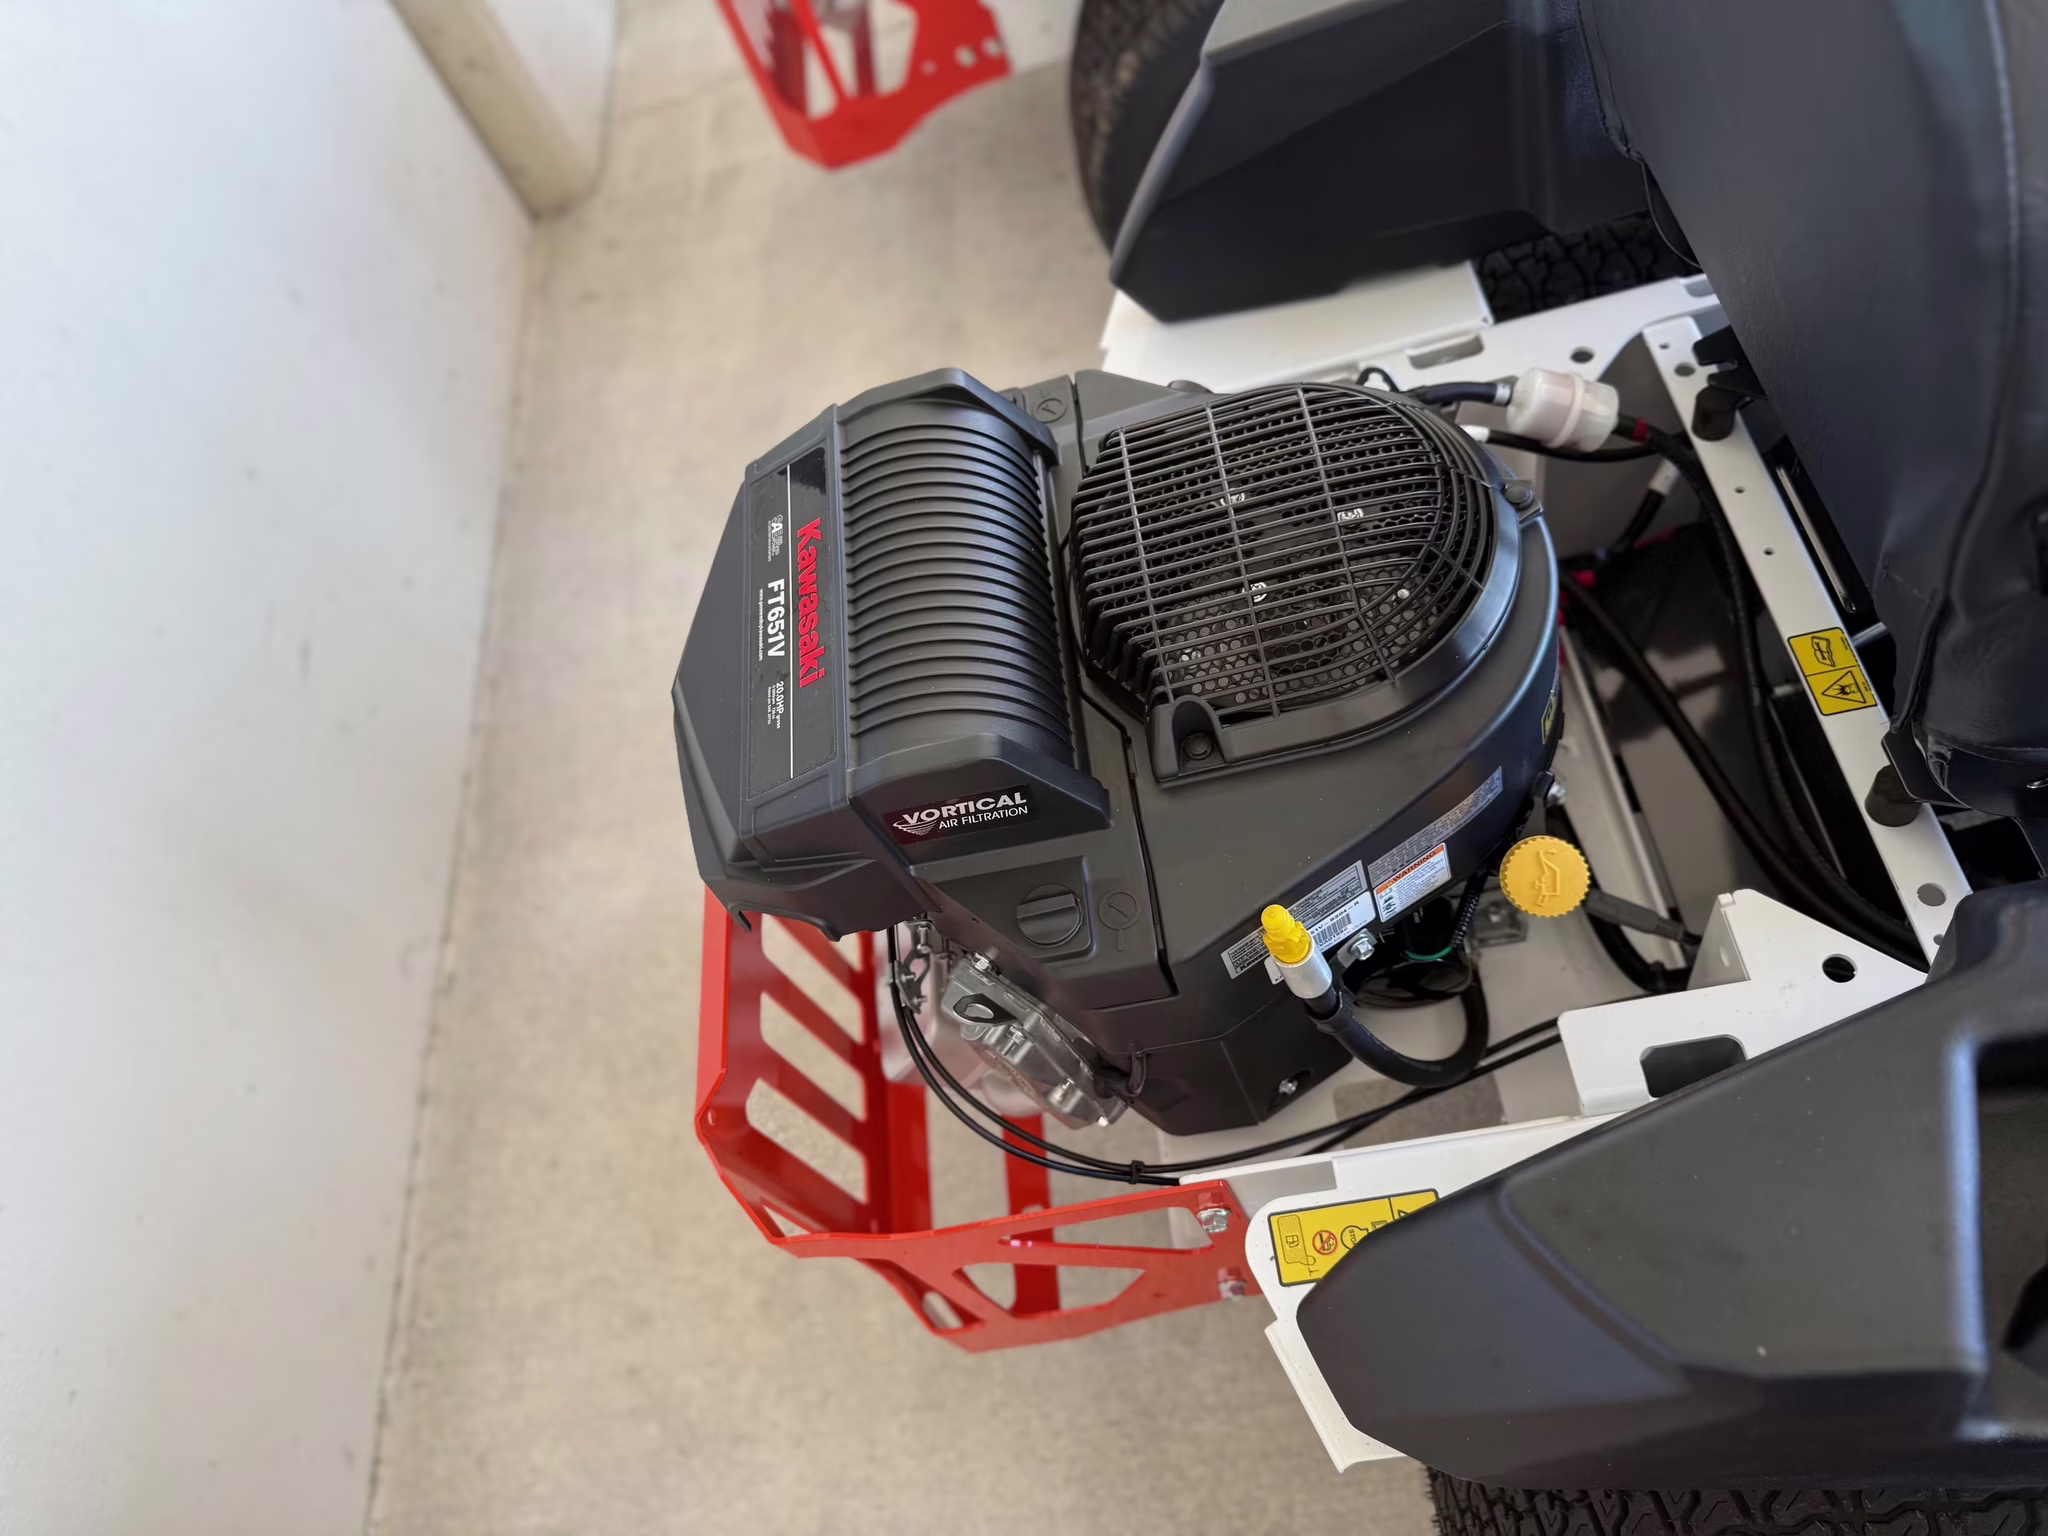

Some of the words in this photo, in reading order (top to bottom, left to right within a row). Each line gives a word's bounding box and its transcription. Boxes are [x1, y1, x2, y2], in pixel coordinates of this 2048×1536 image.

[767, 578, 785, 656] FT651V
[797, 517, 826, 688] Kawasaki
[775, 680, 785, 714] 20.0HP
[902, 792, 1027, 826] VORTICAL
[939, 818, 959, 830] AIR
[961, 805, 1029, 826] FILTRATION
[1392, 851, 1436, 882] WARNING
